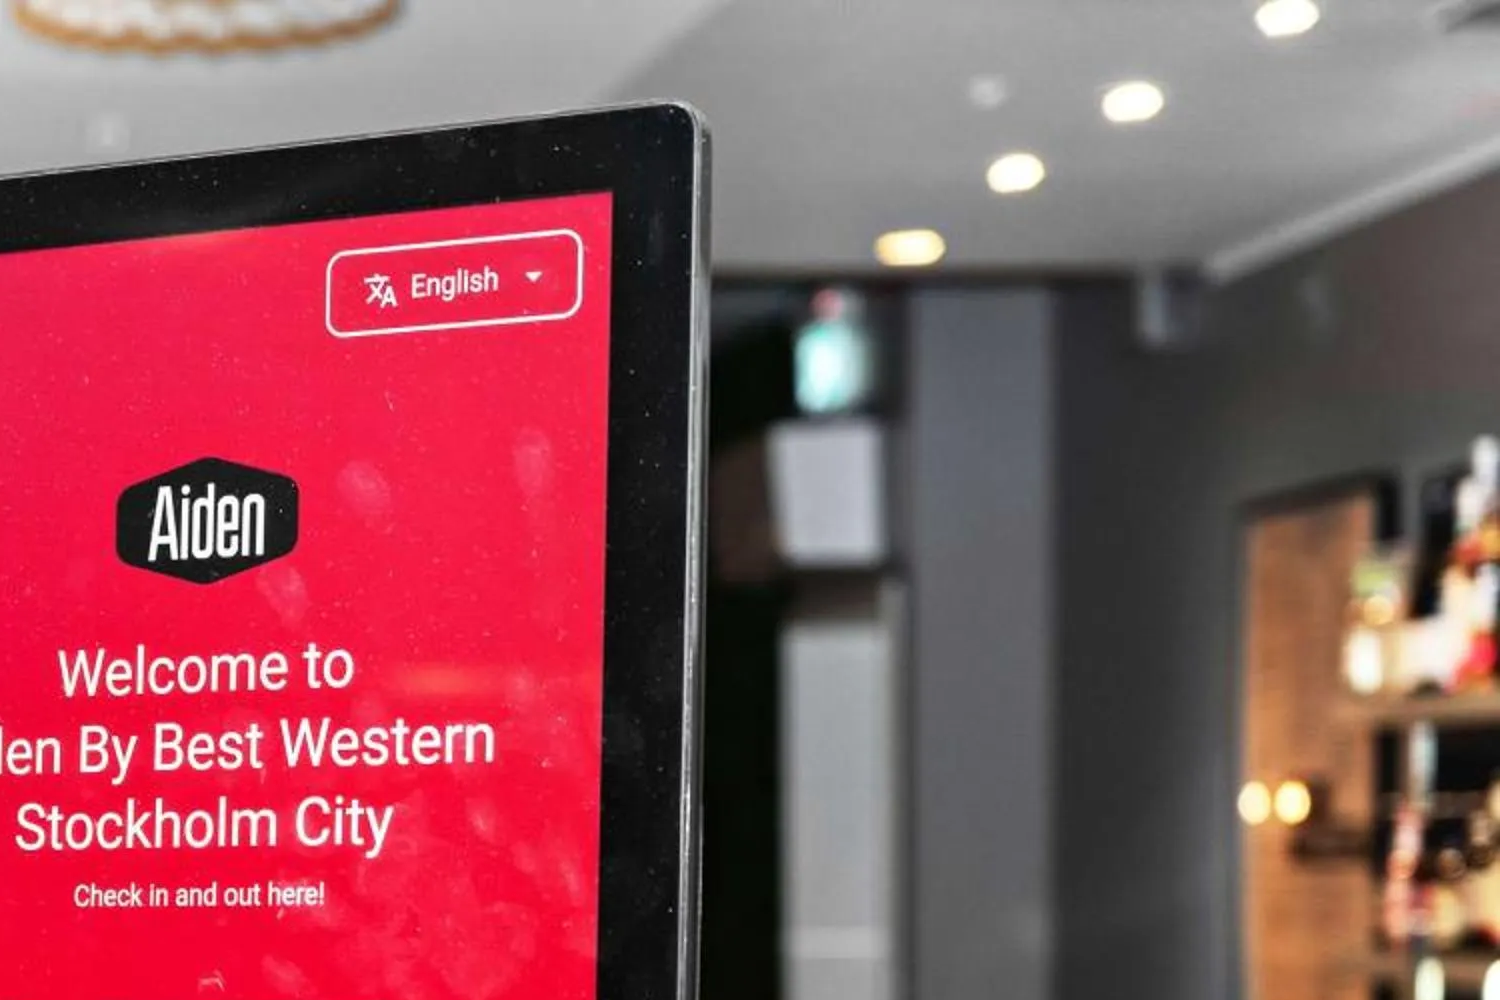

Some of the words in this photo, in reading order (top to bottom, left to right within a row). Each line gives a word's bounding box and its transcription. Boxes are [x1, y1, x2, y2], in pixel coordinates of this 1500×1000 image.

[411, 265, 499, 301] English
[147, 483, 265, 561] Aiden
[58, 644, 288, 698] Welcome
[303, 643, 355, 689] to
[79, 725, 137, 786] By
[153, 722, 263, 771] Best
[280, 717, 495, 767] Western
[15, 798, 277, 851] Stockholm
[296, 796, 394, 858] City
[74, 882, 143, 908] Check
[149, 883, 169, 907] in
[175, 881, 217, 907] and
[223, 883, 261, 907] out
[267, 880, 325, 906] here!
